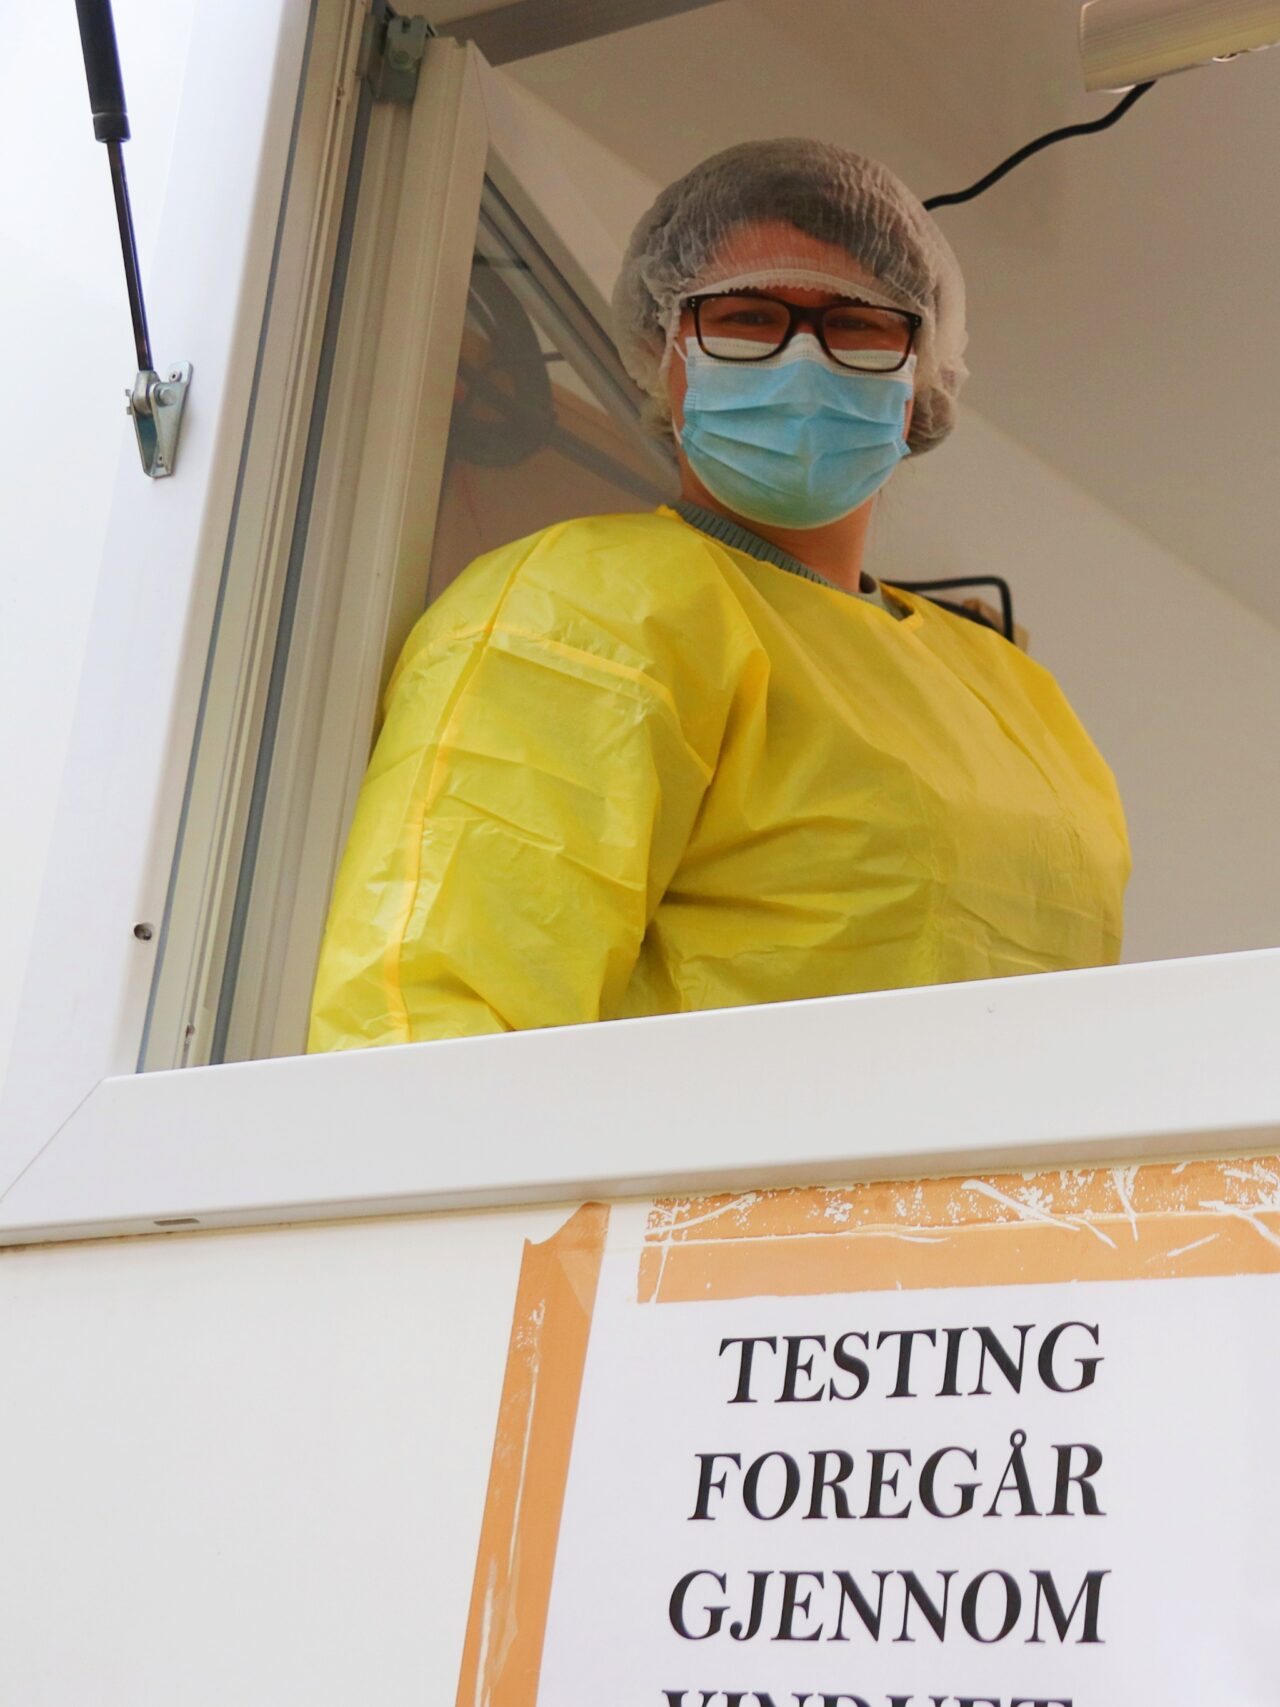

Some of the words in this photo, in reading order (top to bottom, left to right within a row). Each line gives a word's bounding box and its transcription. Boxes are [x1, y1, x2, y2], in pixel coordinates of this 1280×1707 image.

[718, 1321, 1105, 1405] TESTING
[687, 1429, 1107, 1521] FOREGÅR
[668, 1569, 1112, 1644] GJENNOM
